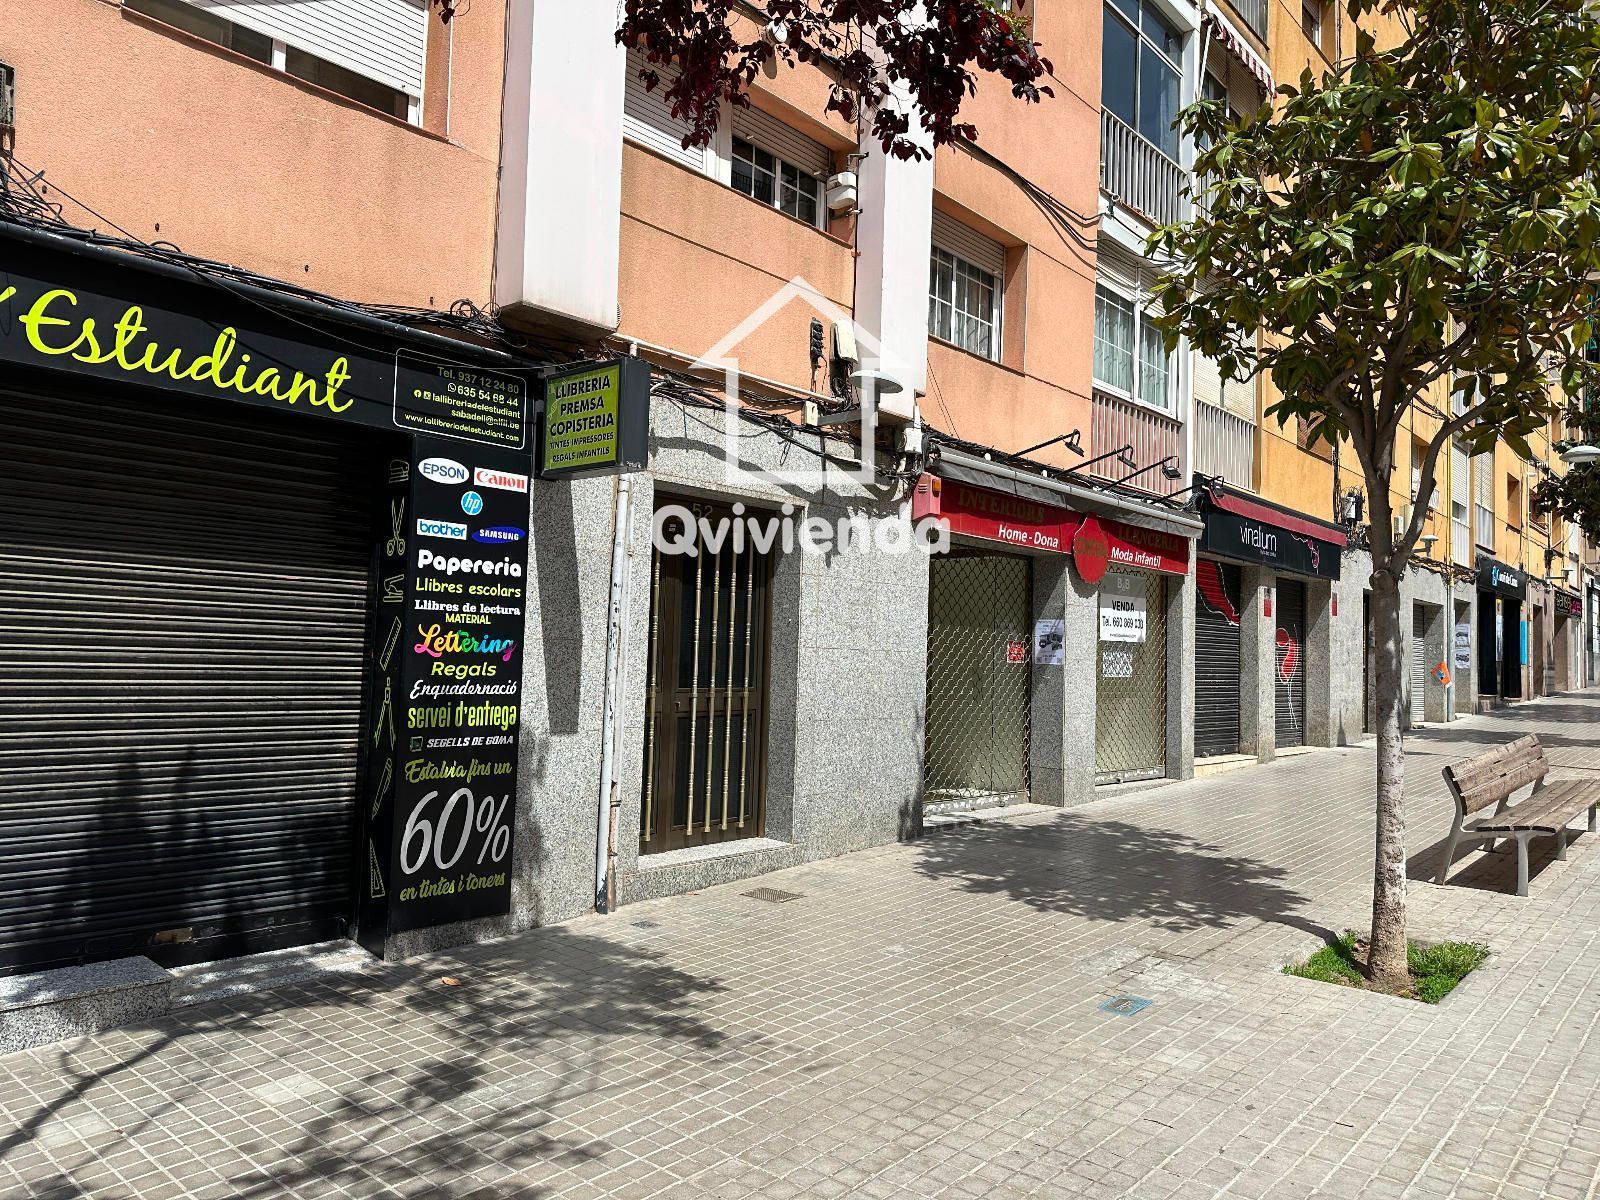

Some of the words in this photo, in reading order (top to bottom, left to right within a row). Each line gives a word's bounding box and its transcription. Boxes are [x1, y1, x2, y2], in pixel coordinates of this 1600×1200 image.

[437, 366, 456, 380] Tel.
[458, 371, 477, 384] 937
[480, 376, 491, 388] 12
[493, 380, 505, 391] 24
[507, 383, 519, 394] 80
[555, 375, 611, 400] LLIBRERIA
[457, 385, 476, 398] 635
[478, 390, 490, 401] 54
[506, 396, 519, 407] 44
[560, 396, 605, 416] PREMSA
[550, 412, 614, 437] COPISTERIA
[549, 439, 570, 450] TINTES
[571, 432, 614, 446] IMPRESSORES
[552, 452, 576, 463] REGALS
[576, 446, 610, 459] INFANTILS
[422, 462, 465, 480] EPSON
[476, 470, 525, 490] Canon
[463, 493, 481, 515] hp
[692, 502, 713, 522] 52
[420, 521, 466, 537] brother
[479, 529, 520, 541] SAMSUNG
[997, 523, 1027, 543] Home
[1033, 531, 1059, 549] Dona
[1240, 521, 1277, 552] vinalum
[417, 549, 522, 578] Papereria
[1111, 546, 1134, 561] Moda
[1135, 551, 1161, 568] Infantil
[415, 577, 463, 594] Llibres
[468, 583, 521, 598] escolars
[414, 599, 459, 613] Llibres
[462, 602, 477, 613] de
[480, 603, 521, 616] lectura
[1111, 599, 1135, 613] VENDA
[445, 613, 492, 625] MATERIAL
[1101, 615, 1112, 627] Tel.
[413, 623, 518, 662] Lettering
[431, 661, 497, 680] Regals
[409, 679, 517, 700] Enquadernació
[407, 702, 452, 729] servei
[455, 700, 517, 731] d'entrega
[426, 736, 470, 748] SEGELLS
[471, 736, 485, 747] DE
[485, 735, 514, 746] GOMA
[404, 758, 467, 784] Estalvia
[466, 758, 492, 784] fins
[493, 761, 513, 775] un
[400, 787, 510, 875] 60%
[399, 886, 418, 902] en
[419, 876, 455, 899] tintes
[457, 874, 464, 892] i
[465, 872, 506, 892] toners
